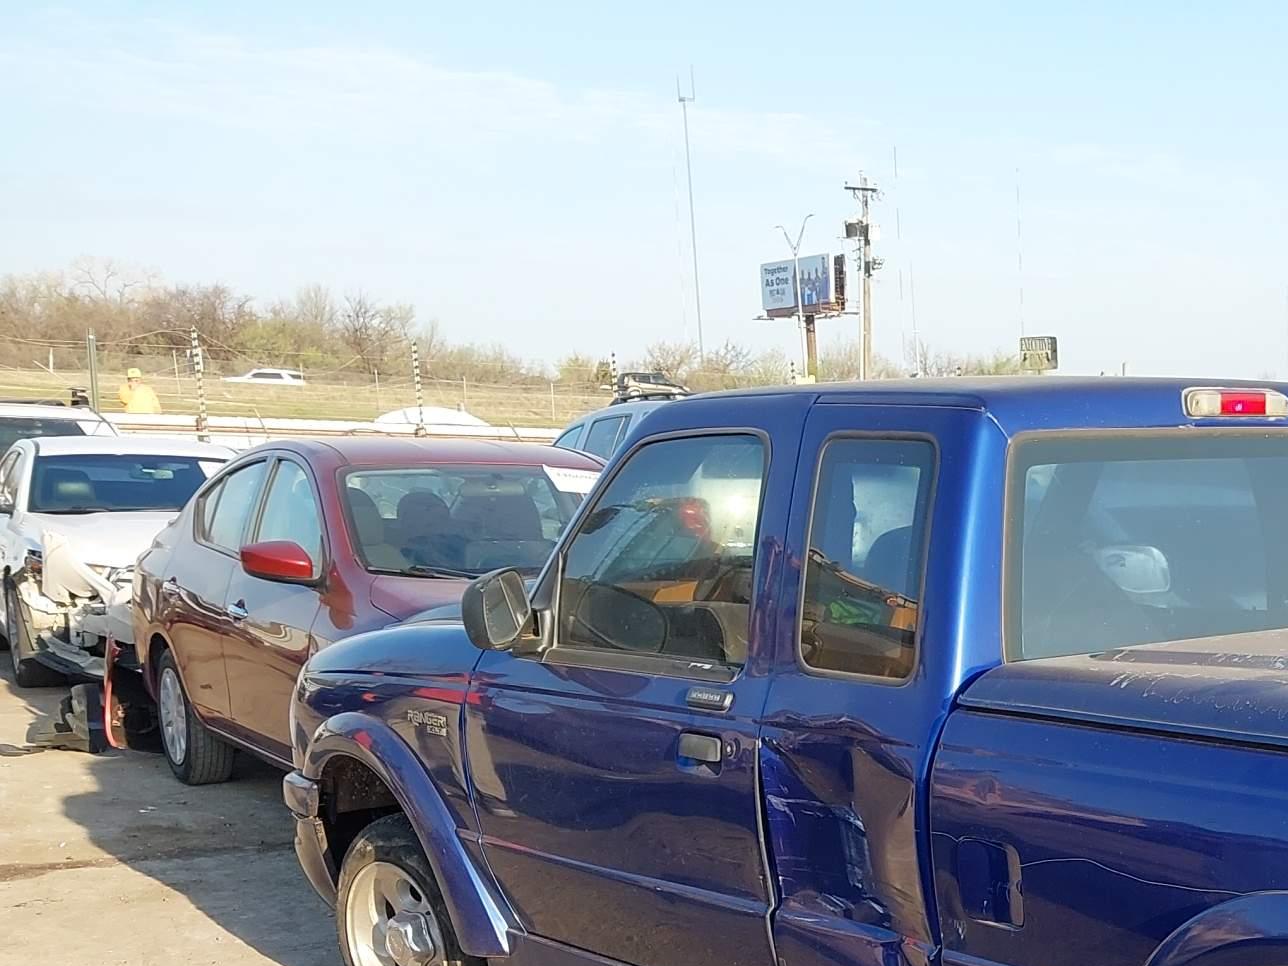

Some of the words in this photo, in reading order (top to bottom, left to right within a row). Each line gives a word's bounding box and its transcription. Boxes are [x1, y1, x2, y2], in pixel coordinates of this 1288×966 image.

[764, 265, 788, 276] Together
[765, 279, 774, 287] As
[775, 276, 789, 286] One
[408, 710, 447, 728] RANGER
